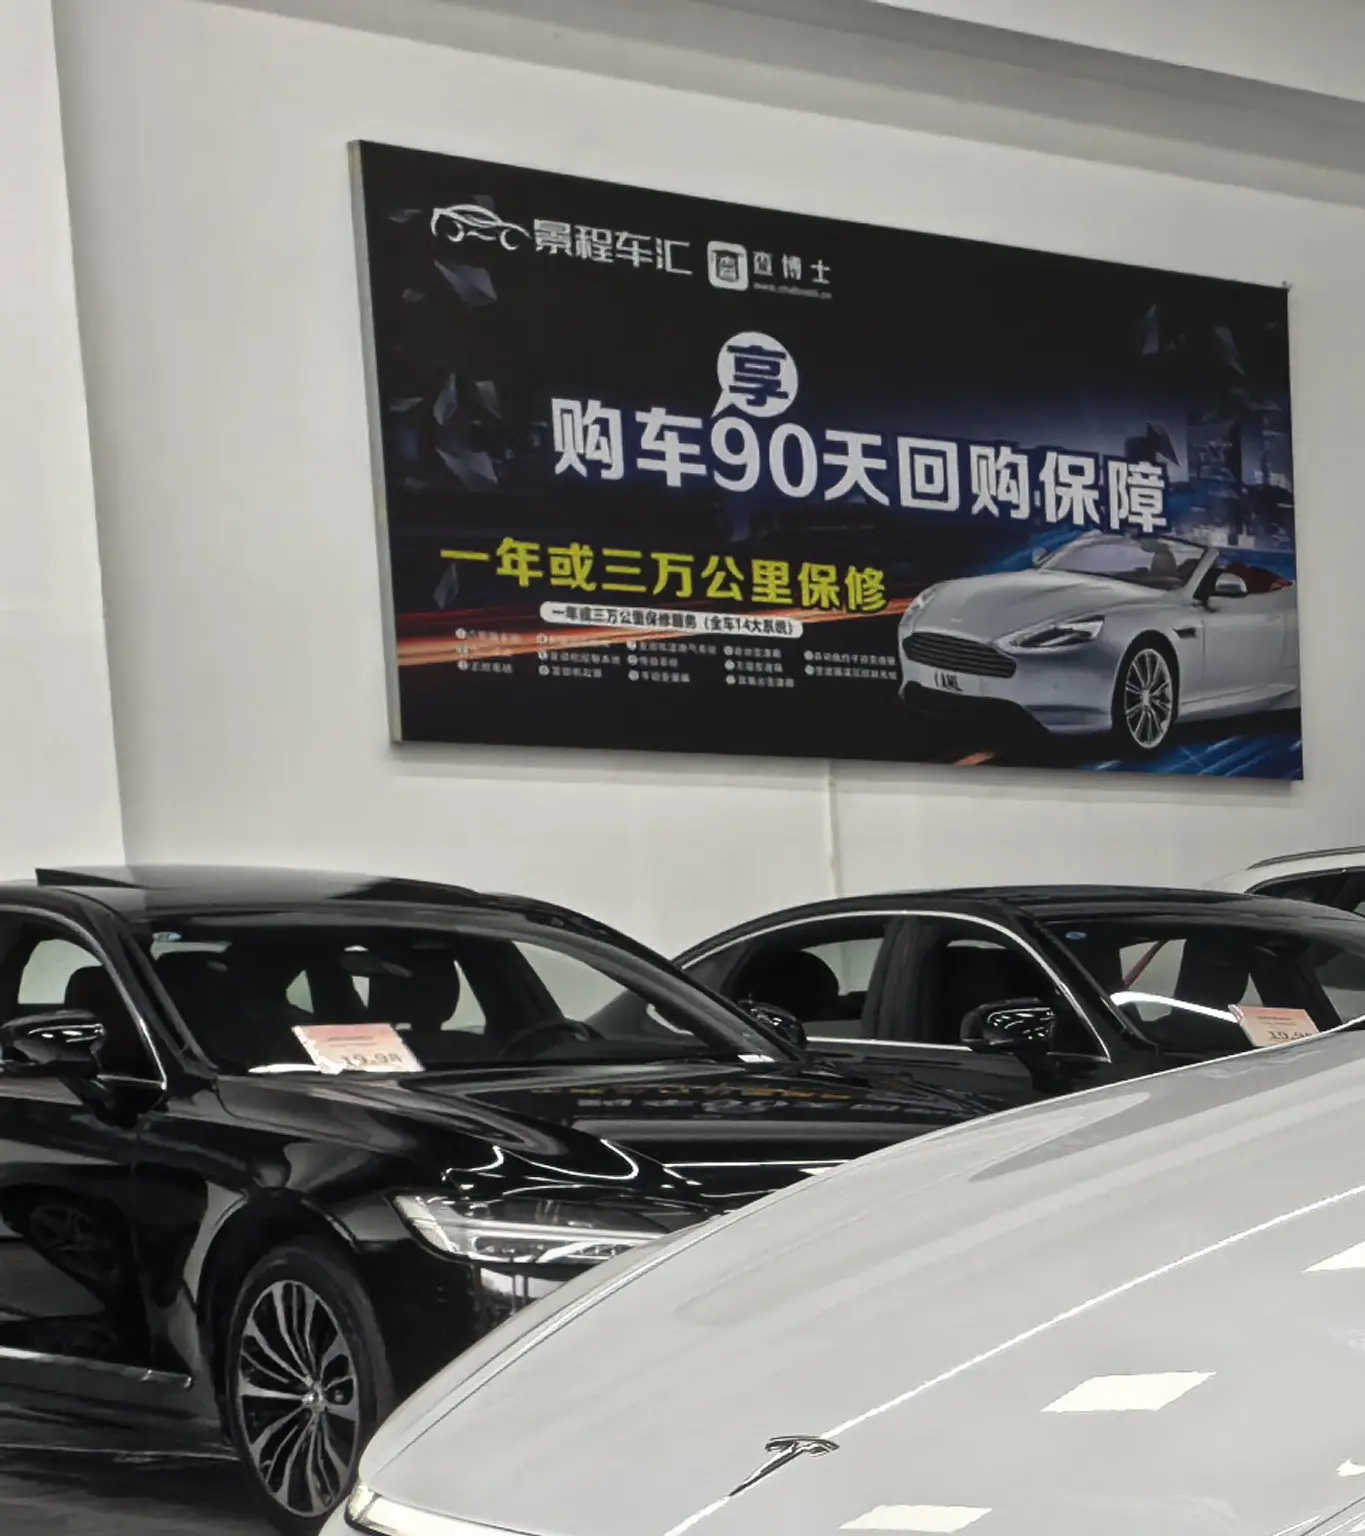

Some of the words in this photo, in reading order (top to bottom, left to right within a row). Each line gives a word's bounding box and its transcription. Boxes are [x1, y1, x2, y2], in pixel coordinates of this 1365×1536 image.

[533, 219, 693, 275] 景程车汇
[726, 344, 790, 406] 享
[551, 398, 1168, 534] 购车90天回购保障
[440, 537, 891, 613] 一年或三万公里保修
